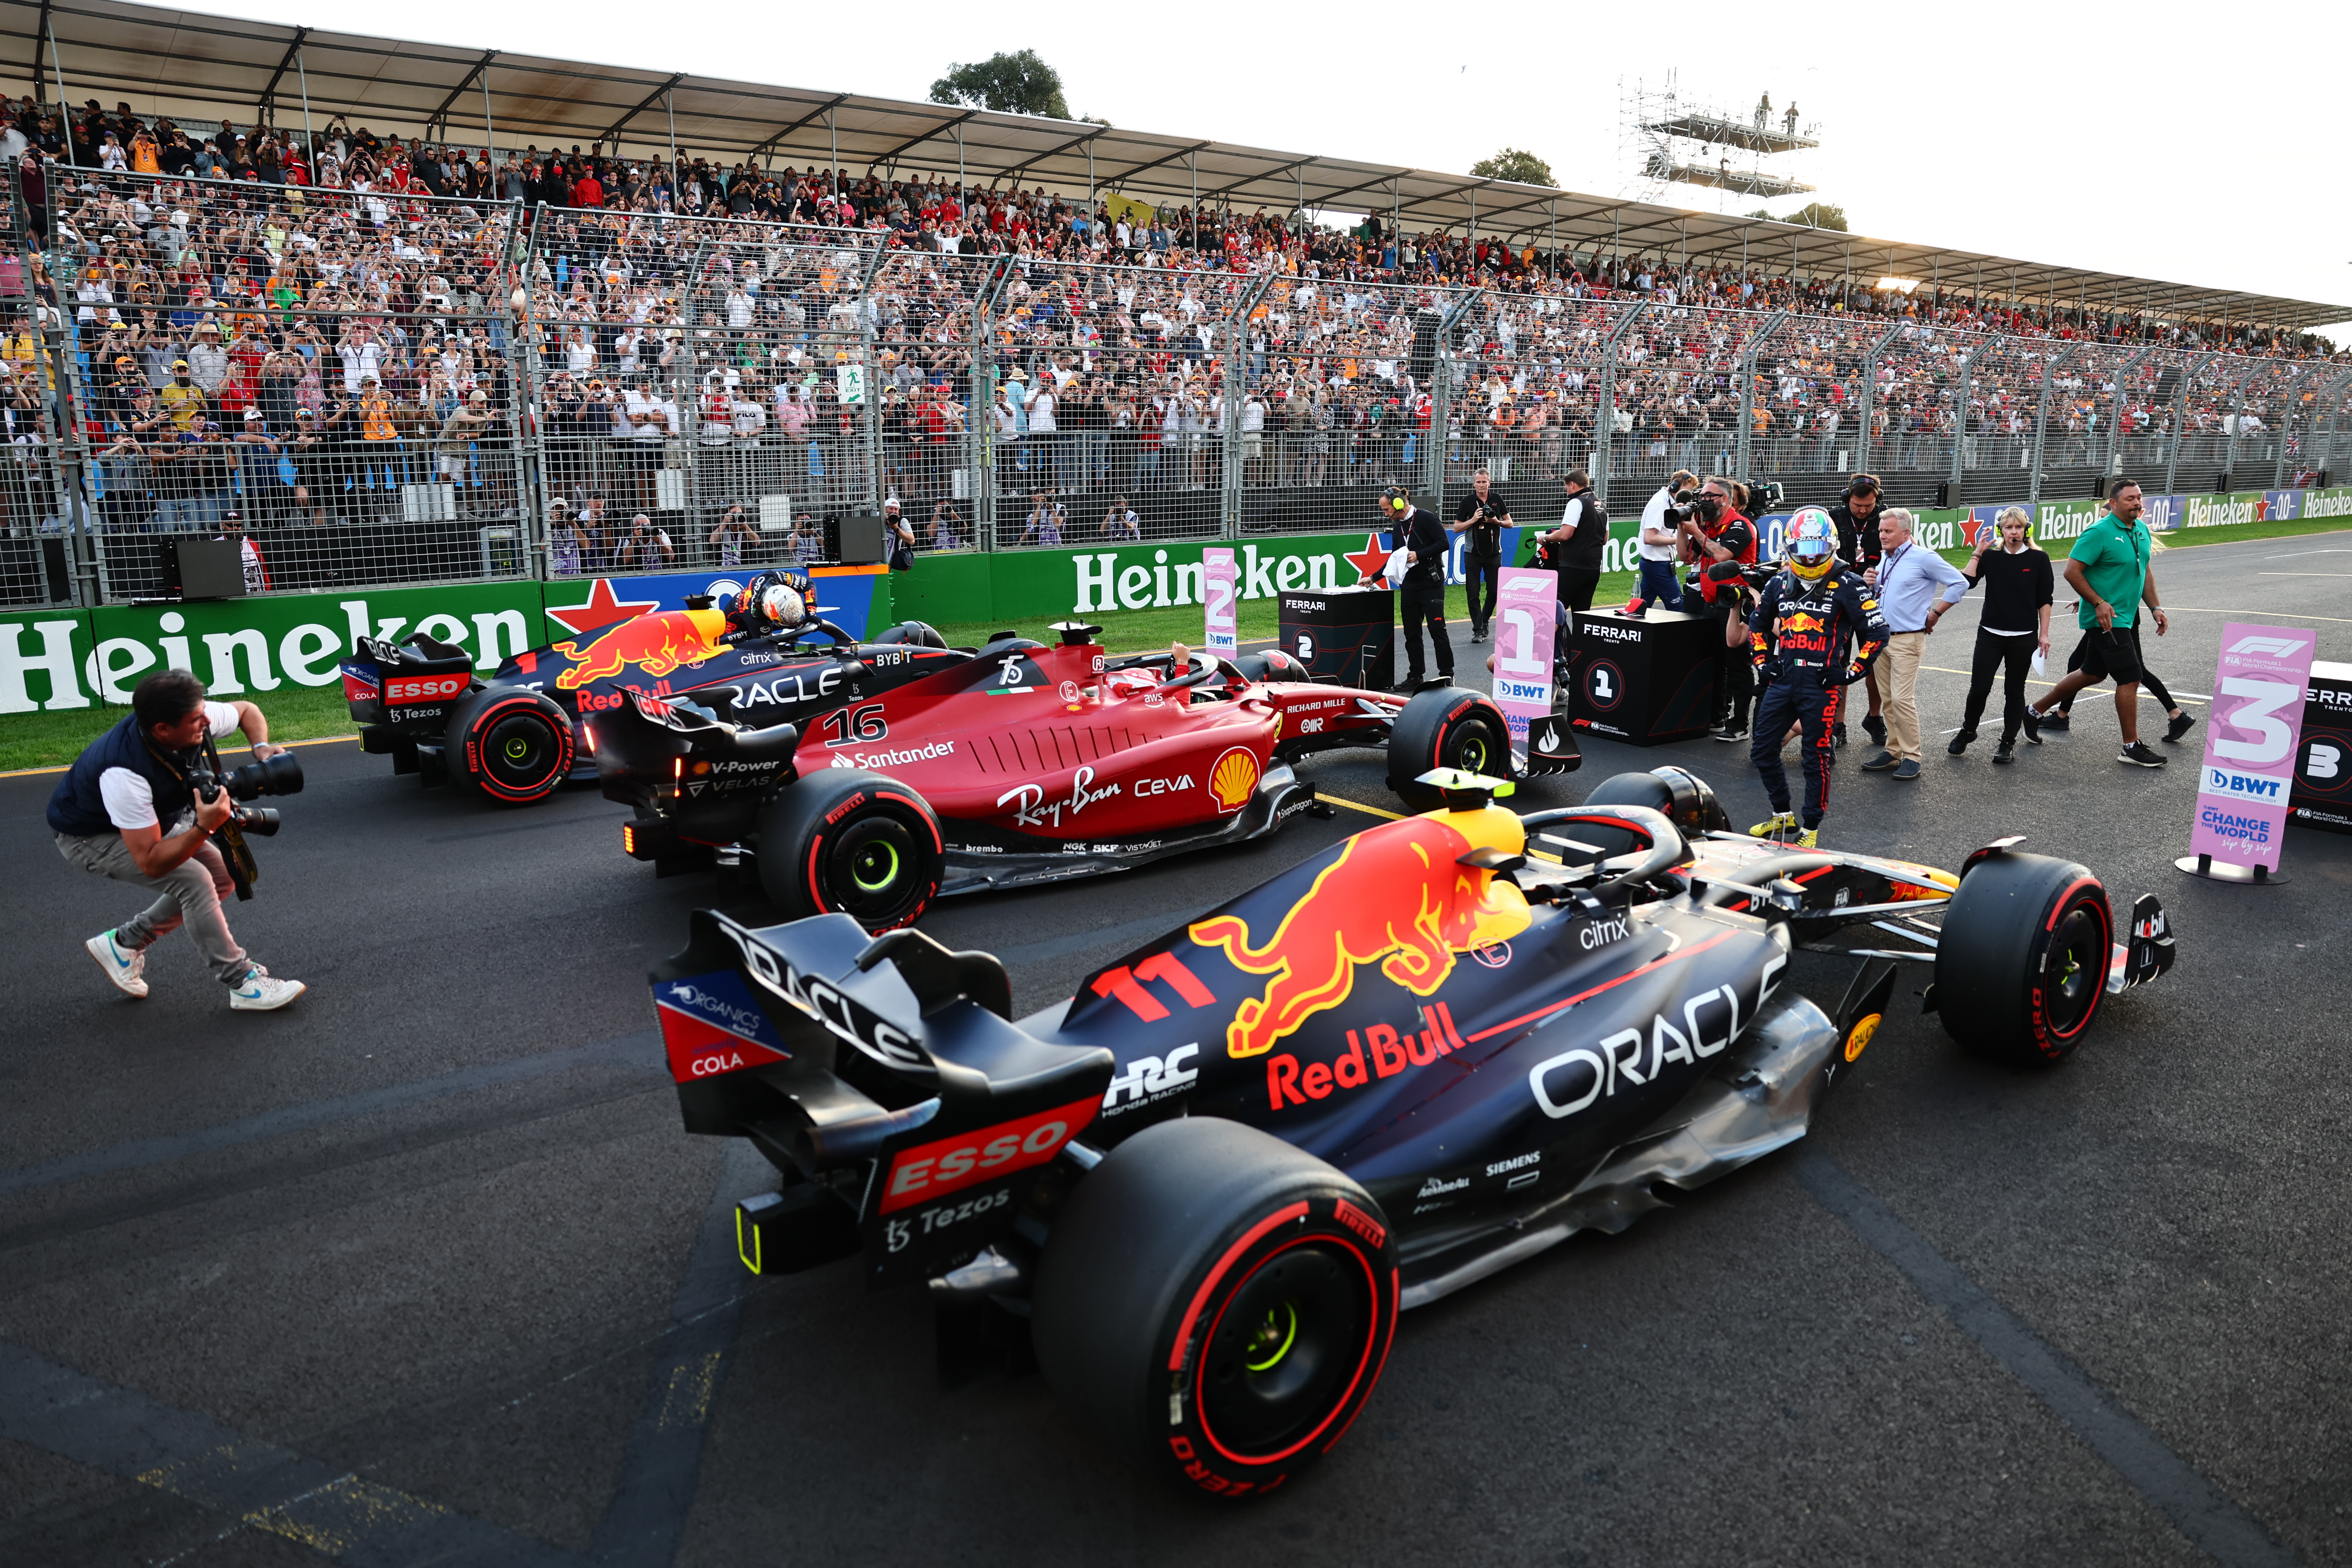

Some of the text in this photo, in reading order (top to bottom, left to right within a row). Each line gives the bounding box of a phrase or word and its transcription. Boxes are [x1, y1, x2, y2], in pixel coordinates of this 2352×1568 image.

[737, 410, 756, 418] FILA
[2187, 496, 2253, 528] Heineken
[2275, 494, 2290, 521] 0.0
[1073, 545, 1337, 613] Heinken
[1207, 579, 1233, 627] 2
[1286, 599, 1325, 610] FERRARI
[1779, 601, 1832, 613] ORACLE
[727, 631, 748, 641] BYBIT
[1216, 635, 1233, 645] BWT
[1501, 609, 1545, 675] 1
[1584, 623, 1641, 642] FERRARI
[1797, 634, 1827, 651] Bull
[0, 601, 528, 712] Heineken
[741, 651, 773, 665] citrix
[877, 649, 912, 667] BYBIT
[1299, 636, 1312, 658] 2
[515, 652, 537, 674] 1
[2225, 655, 2241, 666] FIA
[388, 681, 458, 698] ESSO
[730, 667, 842, 709] RACLE
[1513, 684, 1544, 699] BWT
[1595, 670, 1612, 698] 1
[577, 687, 624, 712] Red
[1144, 693, 1163, 703] aws
[1287, 698, 1345, 714] RICHARD MILLE
[1448, 699, 1473, 721] PIRELLI
[404, 708, 441, 719] Tezos
[2213, 677, 2300, 762] 3
[823, 704, 888, 748] 16
[467, 741, 479, 773] PIRELLI
[561, 724, 574, 771] ZERO
[855, 740, 955, 770] Santander
[712, 759, 779, 773] V-Power
[2307, 743, 2341, 778] 3
[713, 775, 770, 791] VELAS
[2230, 775, 2280, 797] BWT
[825, 791, 865, 824] PIRELLI
[998, 766, 1121, 827] Ray-Ban
[2241, 793, 2277, 804] TECHNOLOGY
[1281, 798, 1312, 820] Snapdragon
[2202, 811, 2270, 833] CHANGE
[2214, 825, 2268, 843] WORLD
[966, 844, 1003, 853] brembo
[1063, 842, 1087, 851] NGK
[1093, 844, 1119, 853] SKF
[2222, 836, 2272, 856] sip by sip
[1835, 888, 1849, 908] FIA
[1580, 913, 1630, 950] citrix
[2135, 909, 2164, 938] Mobil
[1090, 951, 1217, 1023] 11
[680, 985, 760, 1029] ORGANICS
[2033, 987, 2052, 1052] ZERO
[691, 1052, 744, 1076] COLA
[1267, 1001, 1467, 1111] Red Bull
[1102, 1042, 1199, 1109] HRC
[1102, 1080, 1197, 1119] Honda RACING
[889, 1120, 1067, 1197] ESSO
[1486, 1150, 1541, 1177] SIEMENS
[921, 1188, 1010, 1234] Tezos
[1334, 1198, 1386, 1249] PIRELLI
[1169, 1436, 1255, 1496] ZERO
